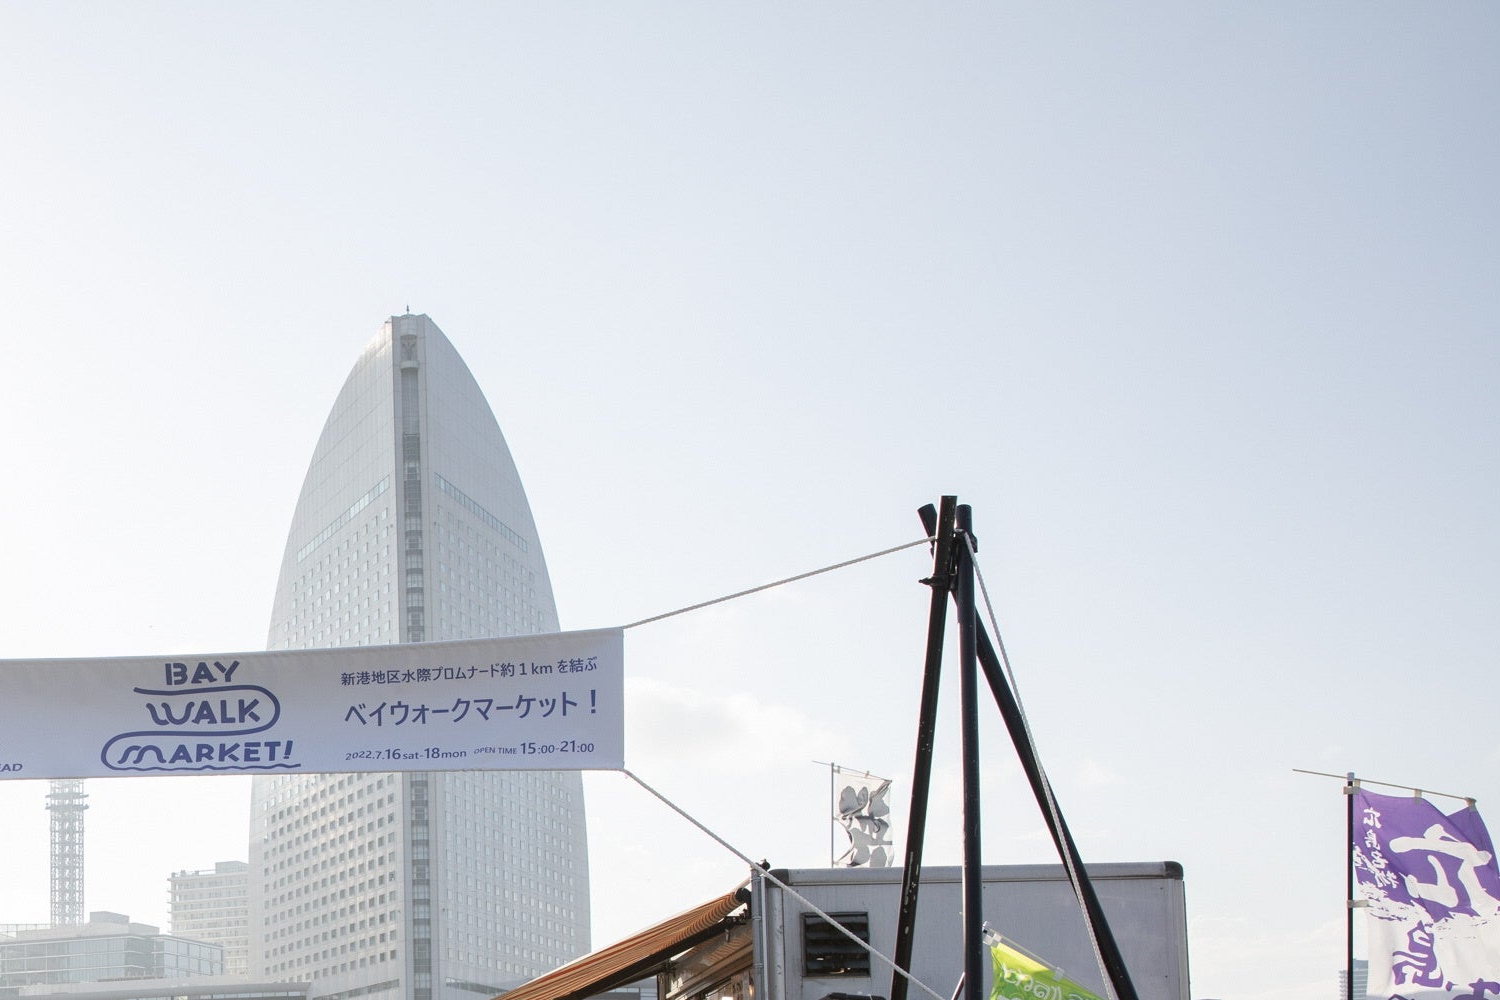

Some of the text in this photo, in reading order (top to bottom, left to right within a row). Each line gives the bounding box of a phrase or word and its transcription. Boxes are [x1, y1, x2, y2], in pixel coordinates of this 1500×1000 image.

[165, 660, 240, 686] BAY
[146, 698, 260, 726] WALK
[117, 739, 294, 765] MARKET!
[474, 746, 496, 756] OPEN
[498, 746, 517, 755] TIME
